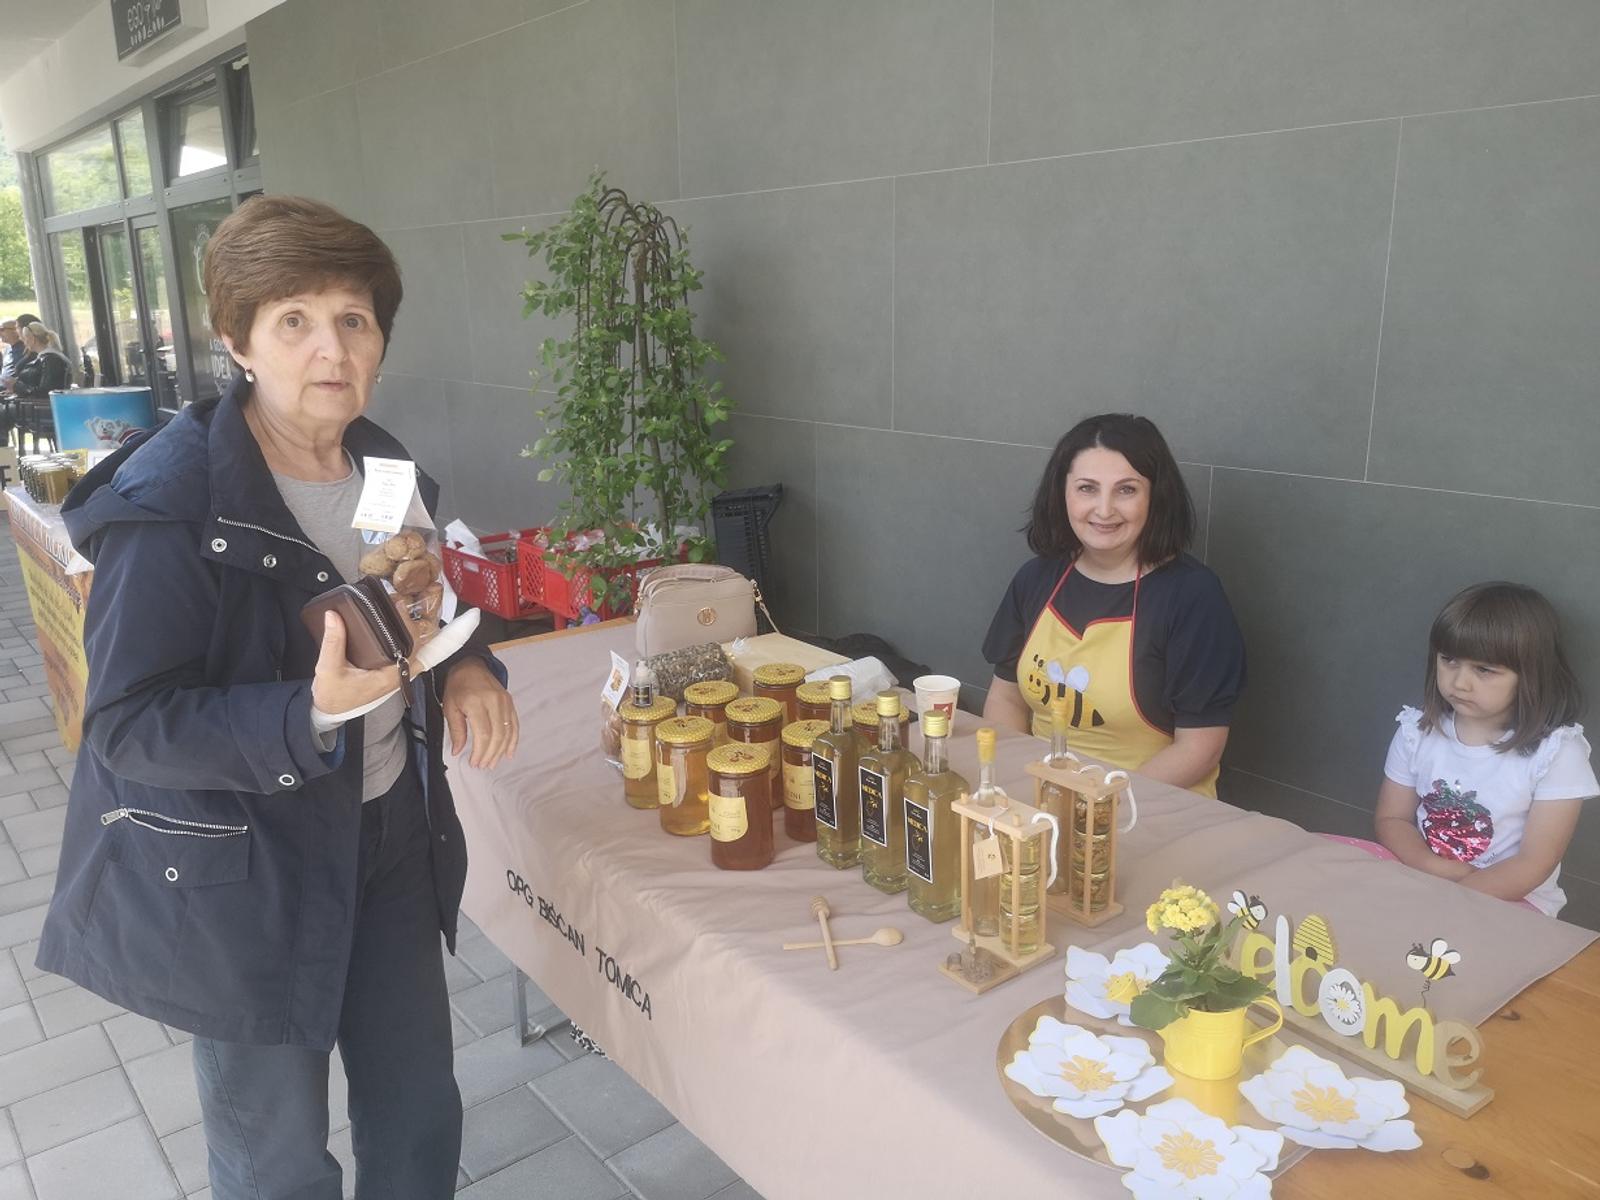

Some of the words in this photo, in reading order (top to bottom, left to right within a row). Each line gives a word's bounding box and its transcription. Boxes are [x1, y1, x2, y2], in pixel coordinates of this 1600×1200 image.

[507, 869, 534, 908] OPG
[596, 946, 652, 1021] TOMICA
[1228, 914, 1482, 1091] elcome
